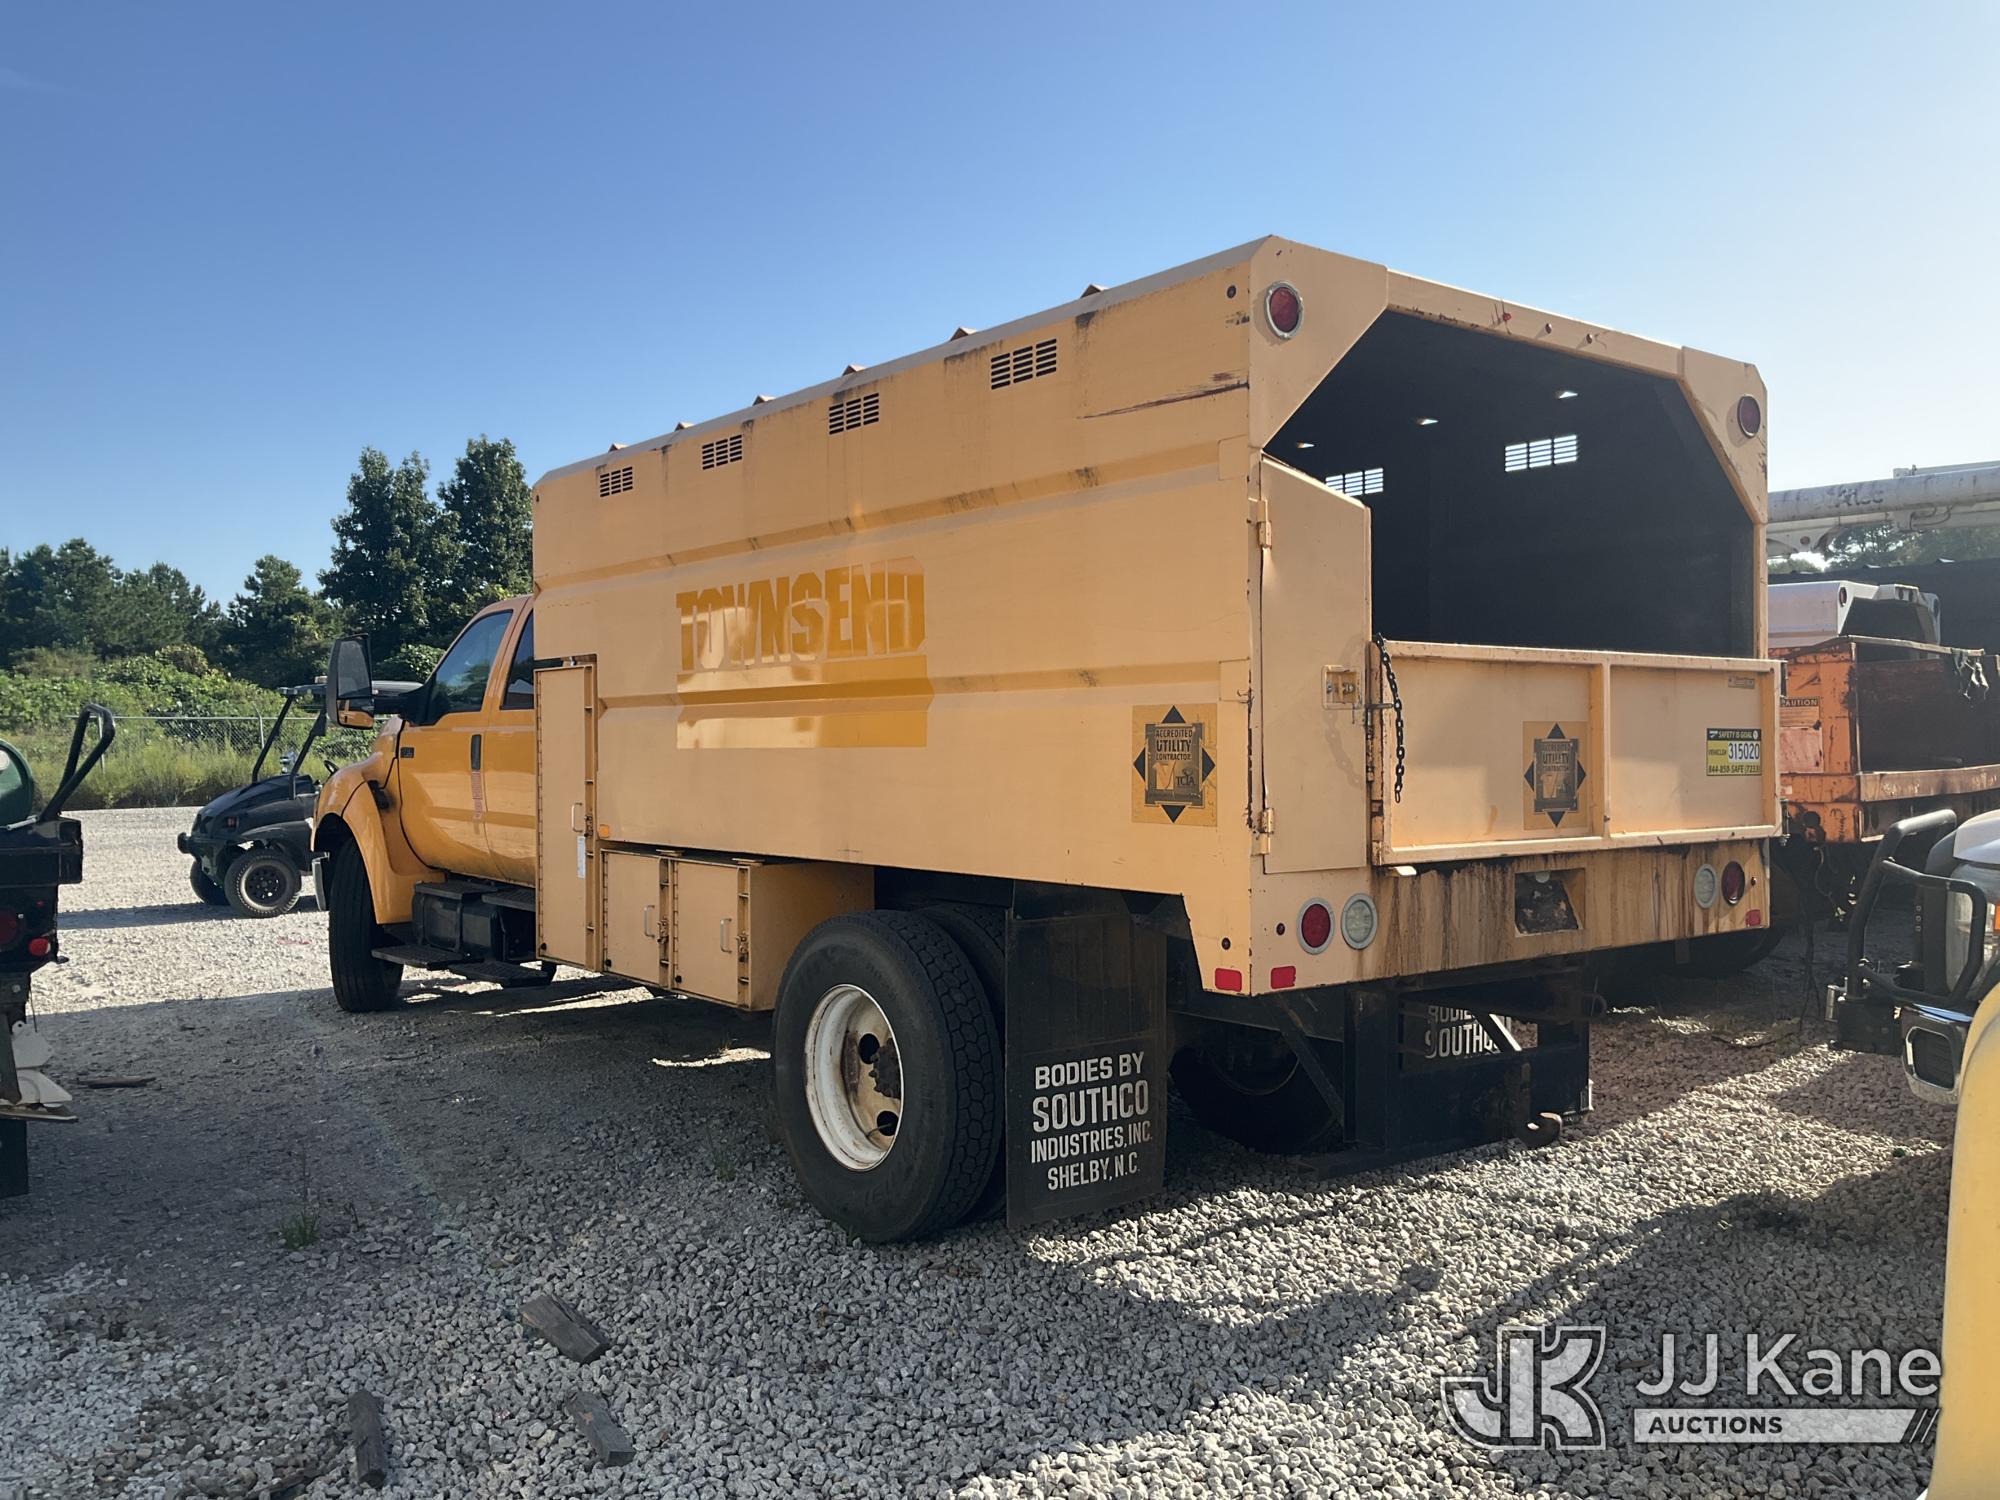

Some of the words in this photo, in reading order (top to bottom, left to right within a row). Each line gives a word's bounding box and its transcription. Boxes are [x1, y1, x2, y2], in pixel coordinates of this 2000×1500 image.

[676, 555, 926, 671] TOWNSEND
[1155, 729, 1193, 738] ACCREDITED
[1156, 739, 1192, 752] UTILITY
[1728, 742, 1760, 760] 315020
[1035, 1056, 1114, 1090] BODIES
[1118, 1051, 1145, 1077] BY
[1032, 1079, 1149, 1133] SOUTHCO
[1031, 1126, 1128, 1163] INDUSTRIES,
[1128, 1120, 1153, 1145] INC.
[1047, 1157, 1114, 1191] SHELBY,
[1114, 1151, 1141, 1178] N.C.
